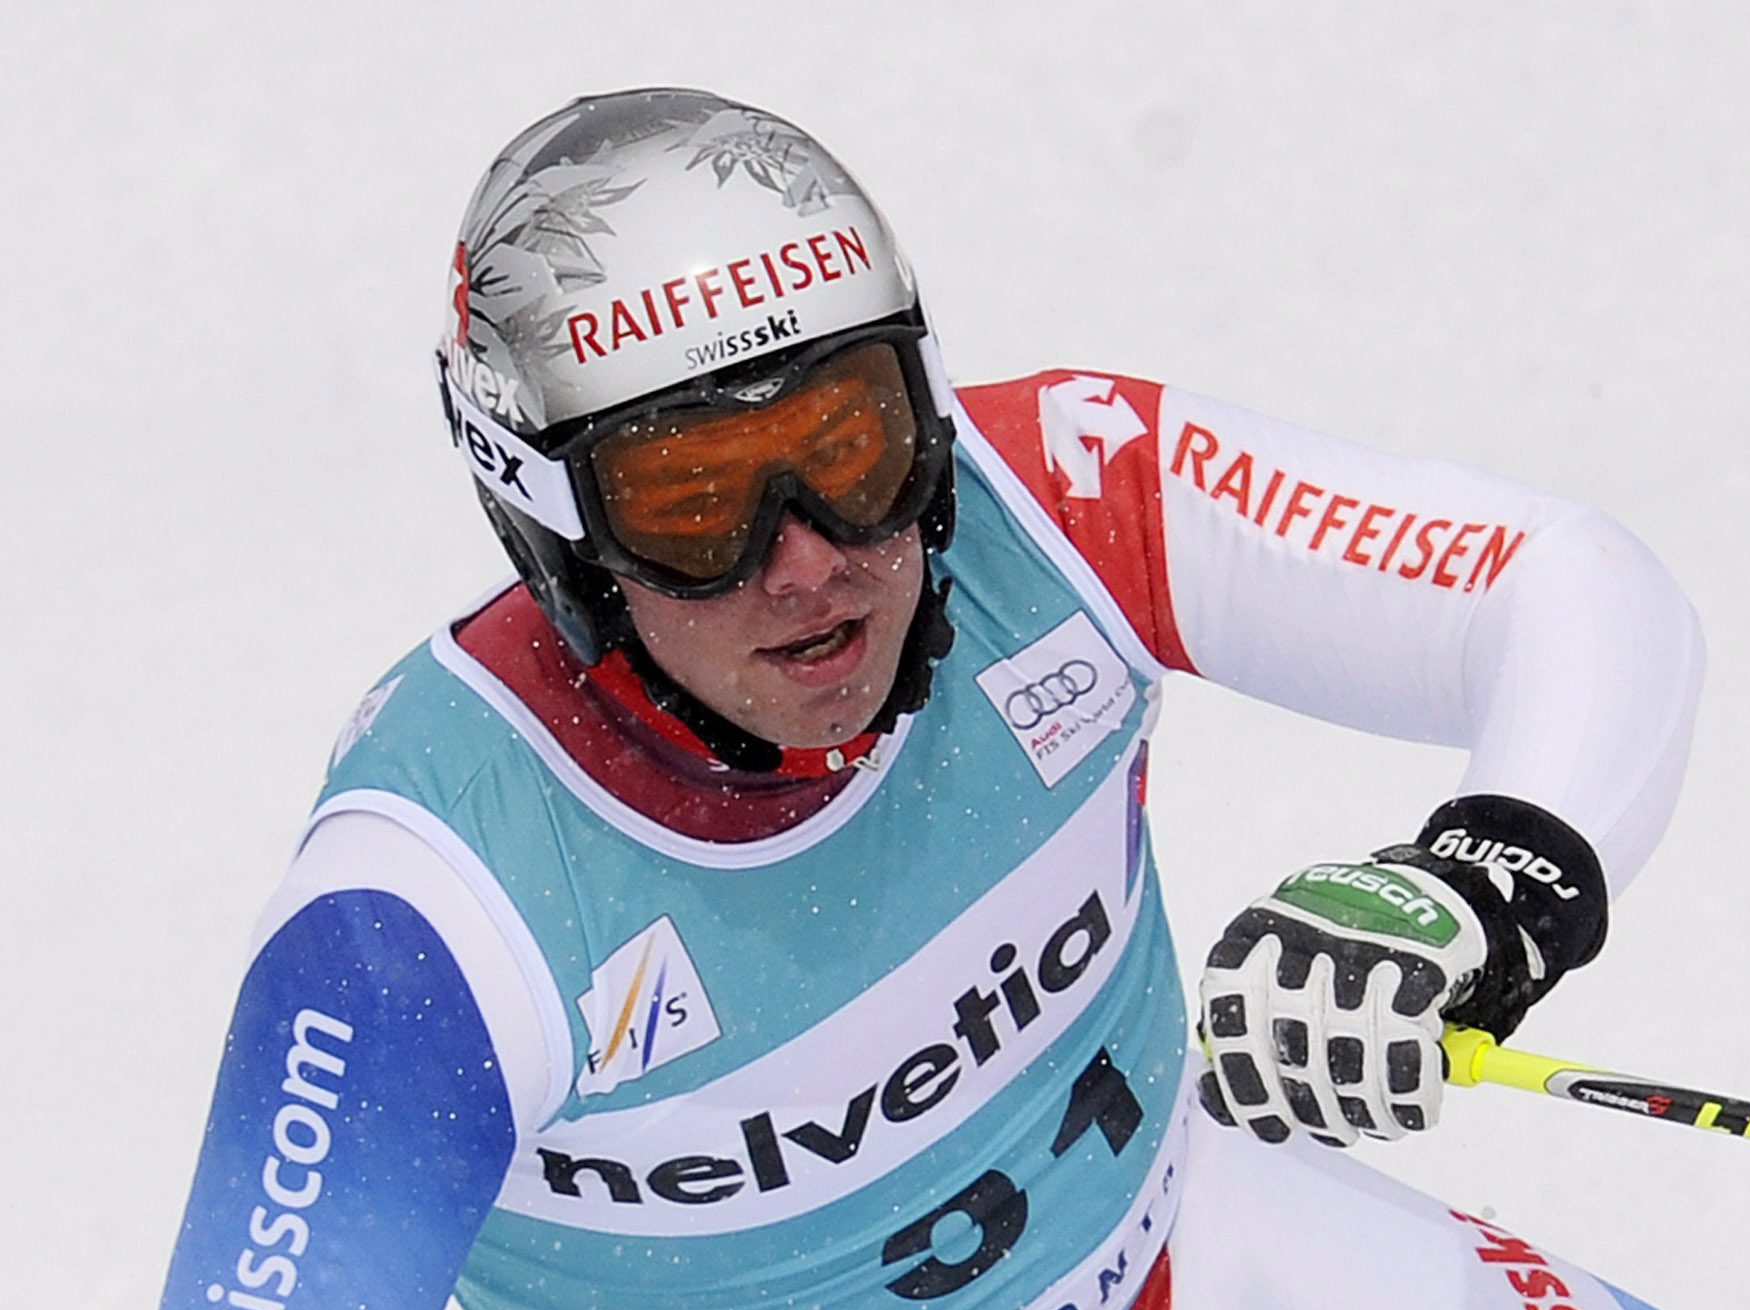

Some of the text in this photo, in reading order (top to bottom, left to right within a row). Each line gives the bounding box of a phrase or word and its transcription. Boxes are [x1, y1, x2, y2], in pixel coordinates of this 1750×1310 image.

[566, 226, 872, 364] RAIFFEISEN
[684, 309, 801, 370] swissski
[1169, 420, 1527, 593] RAIFFEISEN
[1030, 722, 1063, 750] Audi
[1429, 828, 1581, 900] racing
